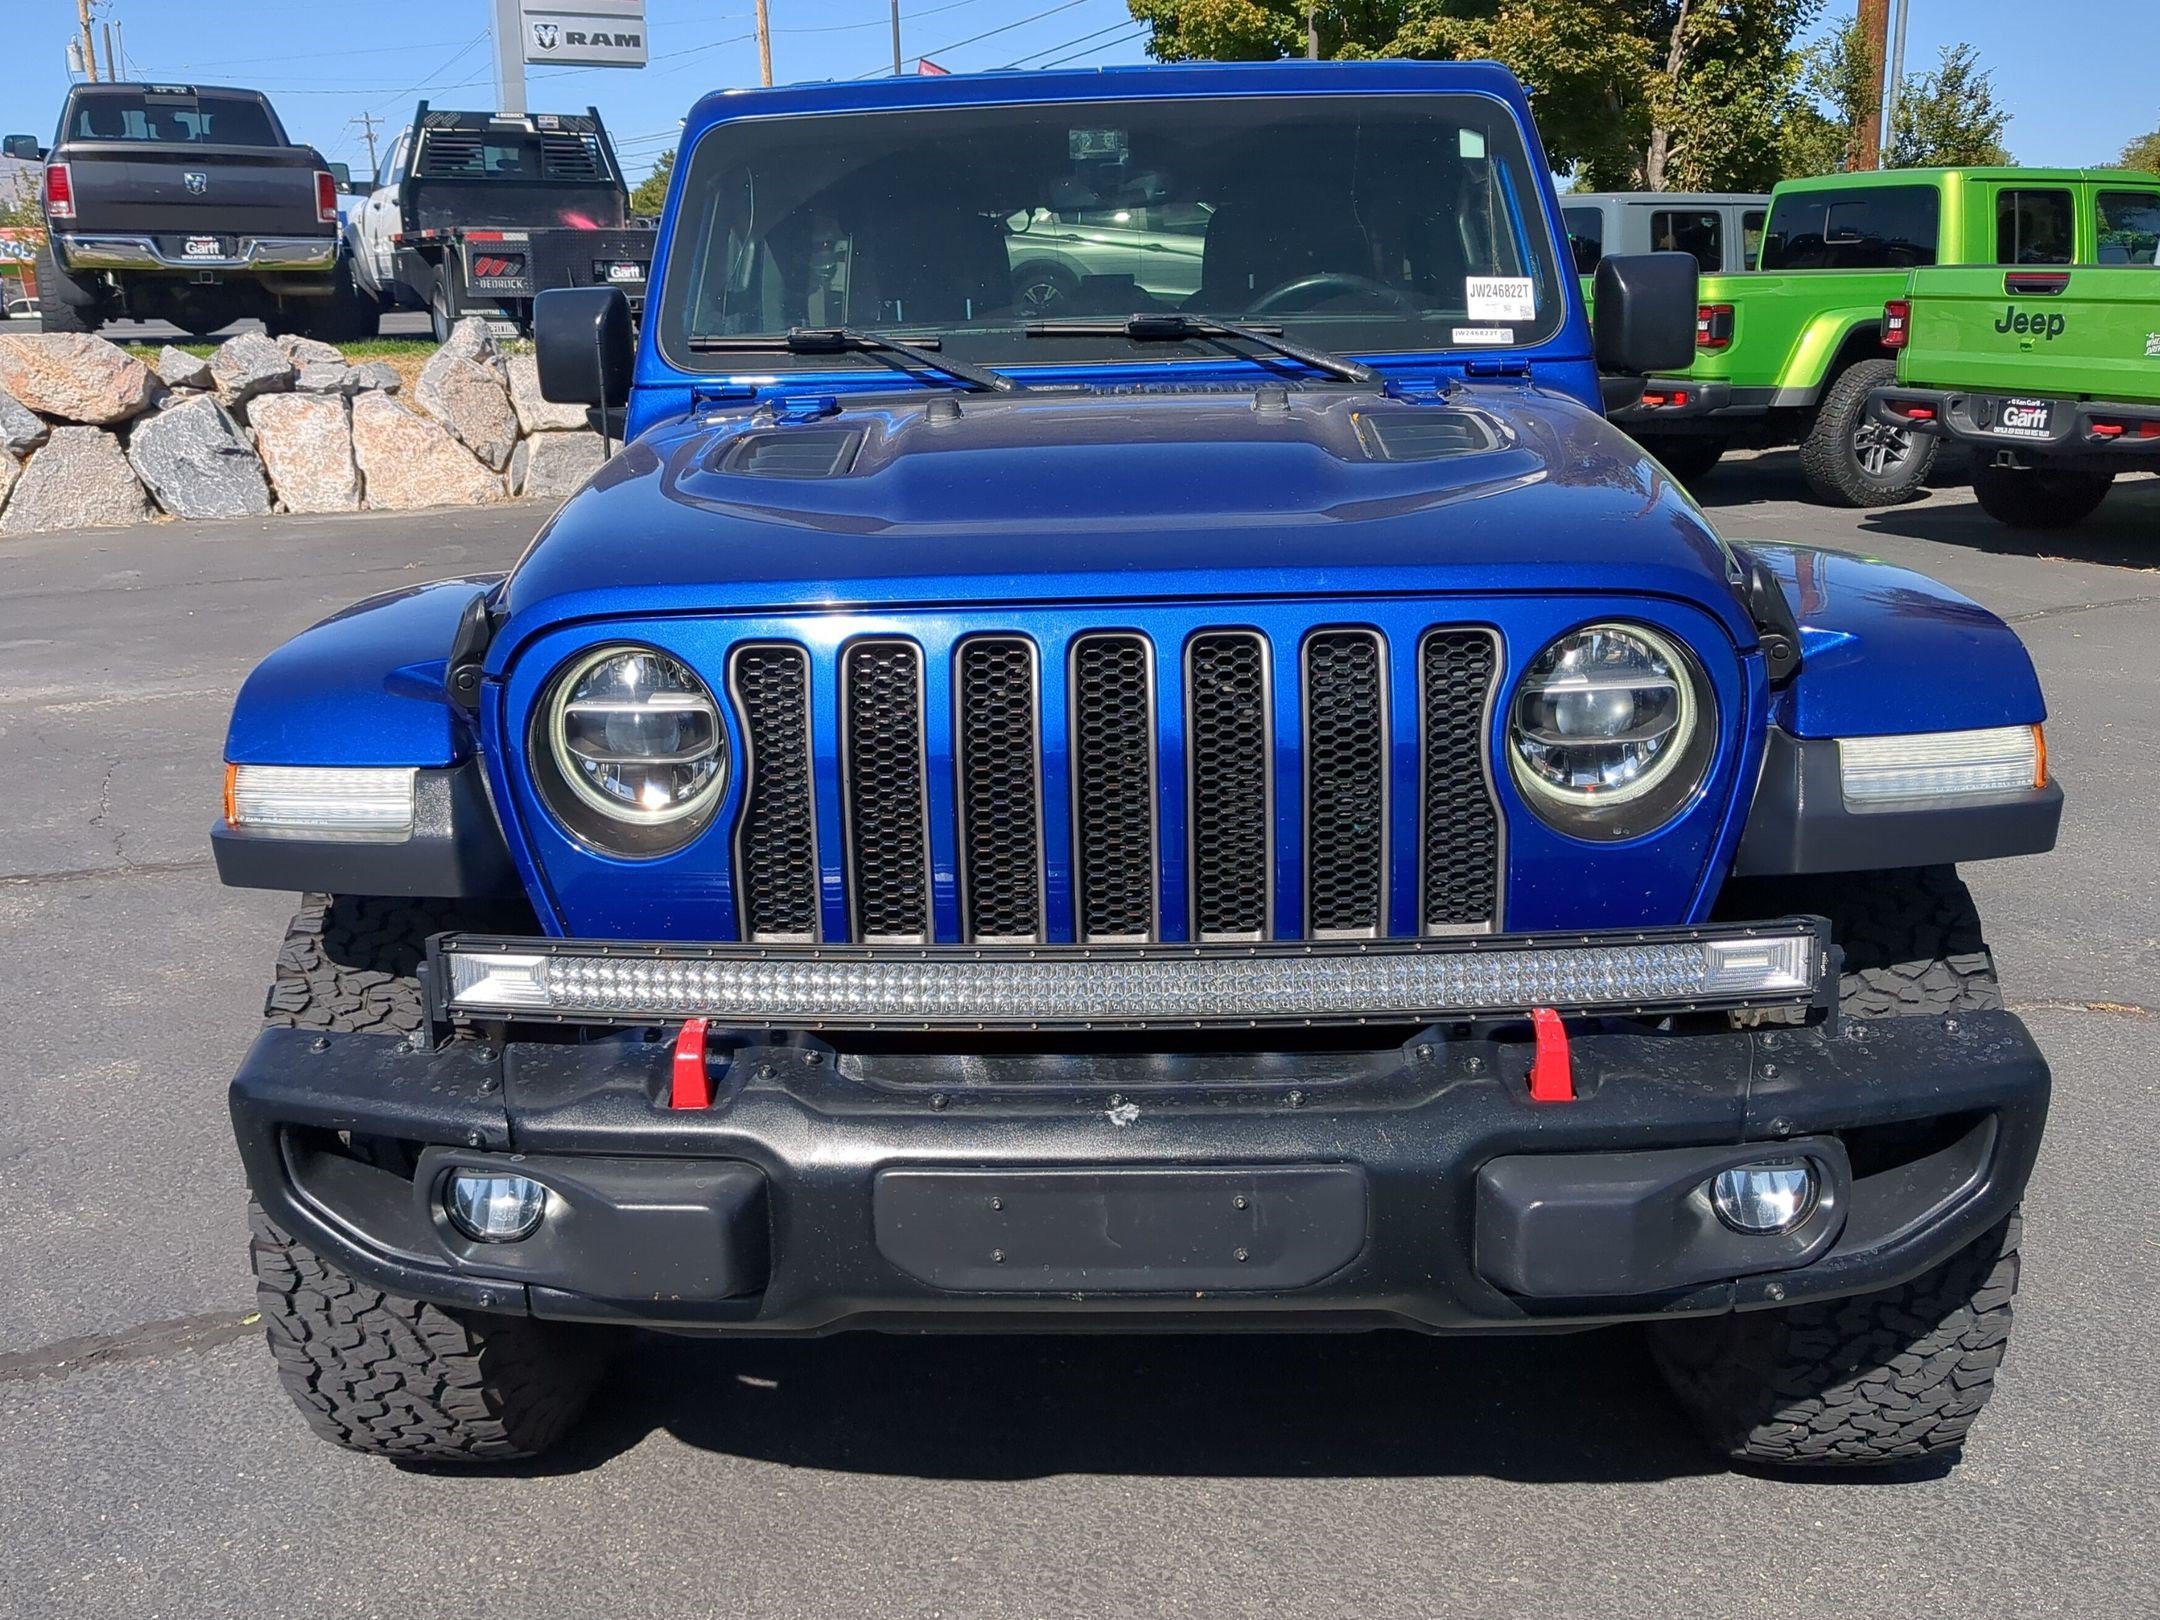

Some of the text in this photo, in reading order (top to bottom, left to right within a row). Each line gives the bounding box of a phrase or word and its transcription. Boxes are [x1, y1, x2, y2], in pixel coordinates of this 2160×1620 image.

[566, 32, 641, 48] RAM
[185, 241, 220, 255] Garff
[610, 265, 640, 278] Garff
[480, 279, 523, 289] BEDROCK
[1470, 283, 1529, 298] JW246822T
[1994, 305, 2065, 341] Jeep
[2003, 406, 2048, 429] Garff
